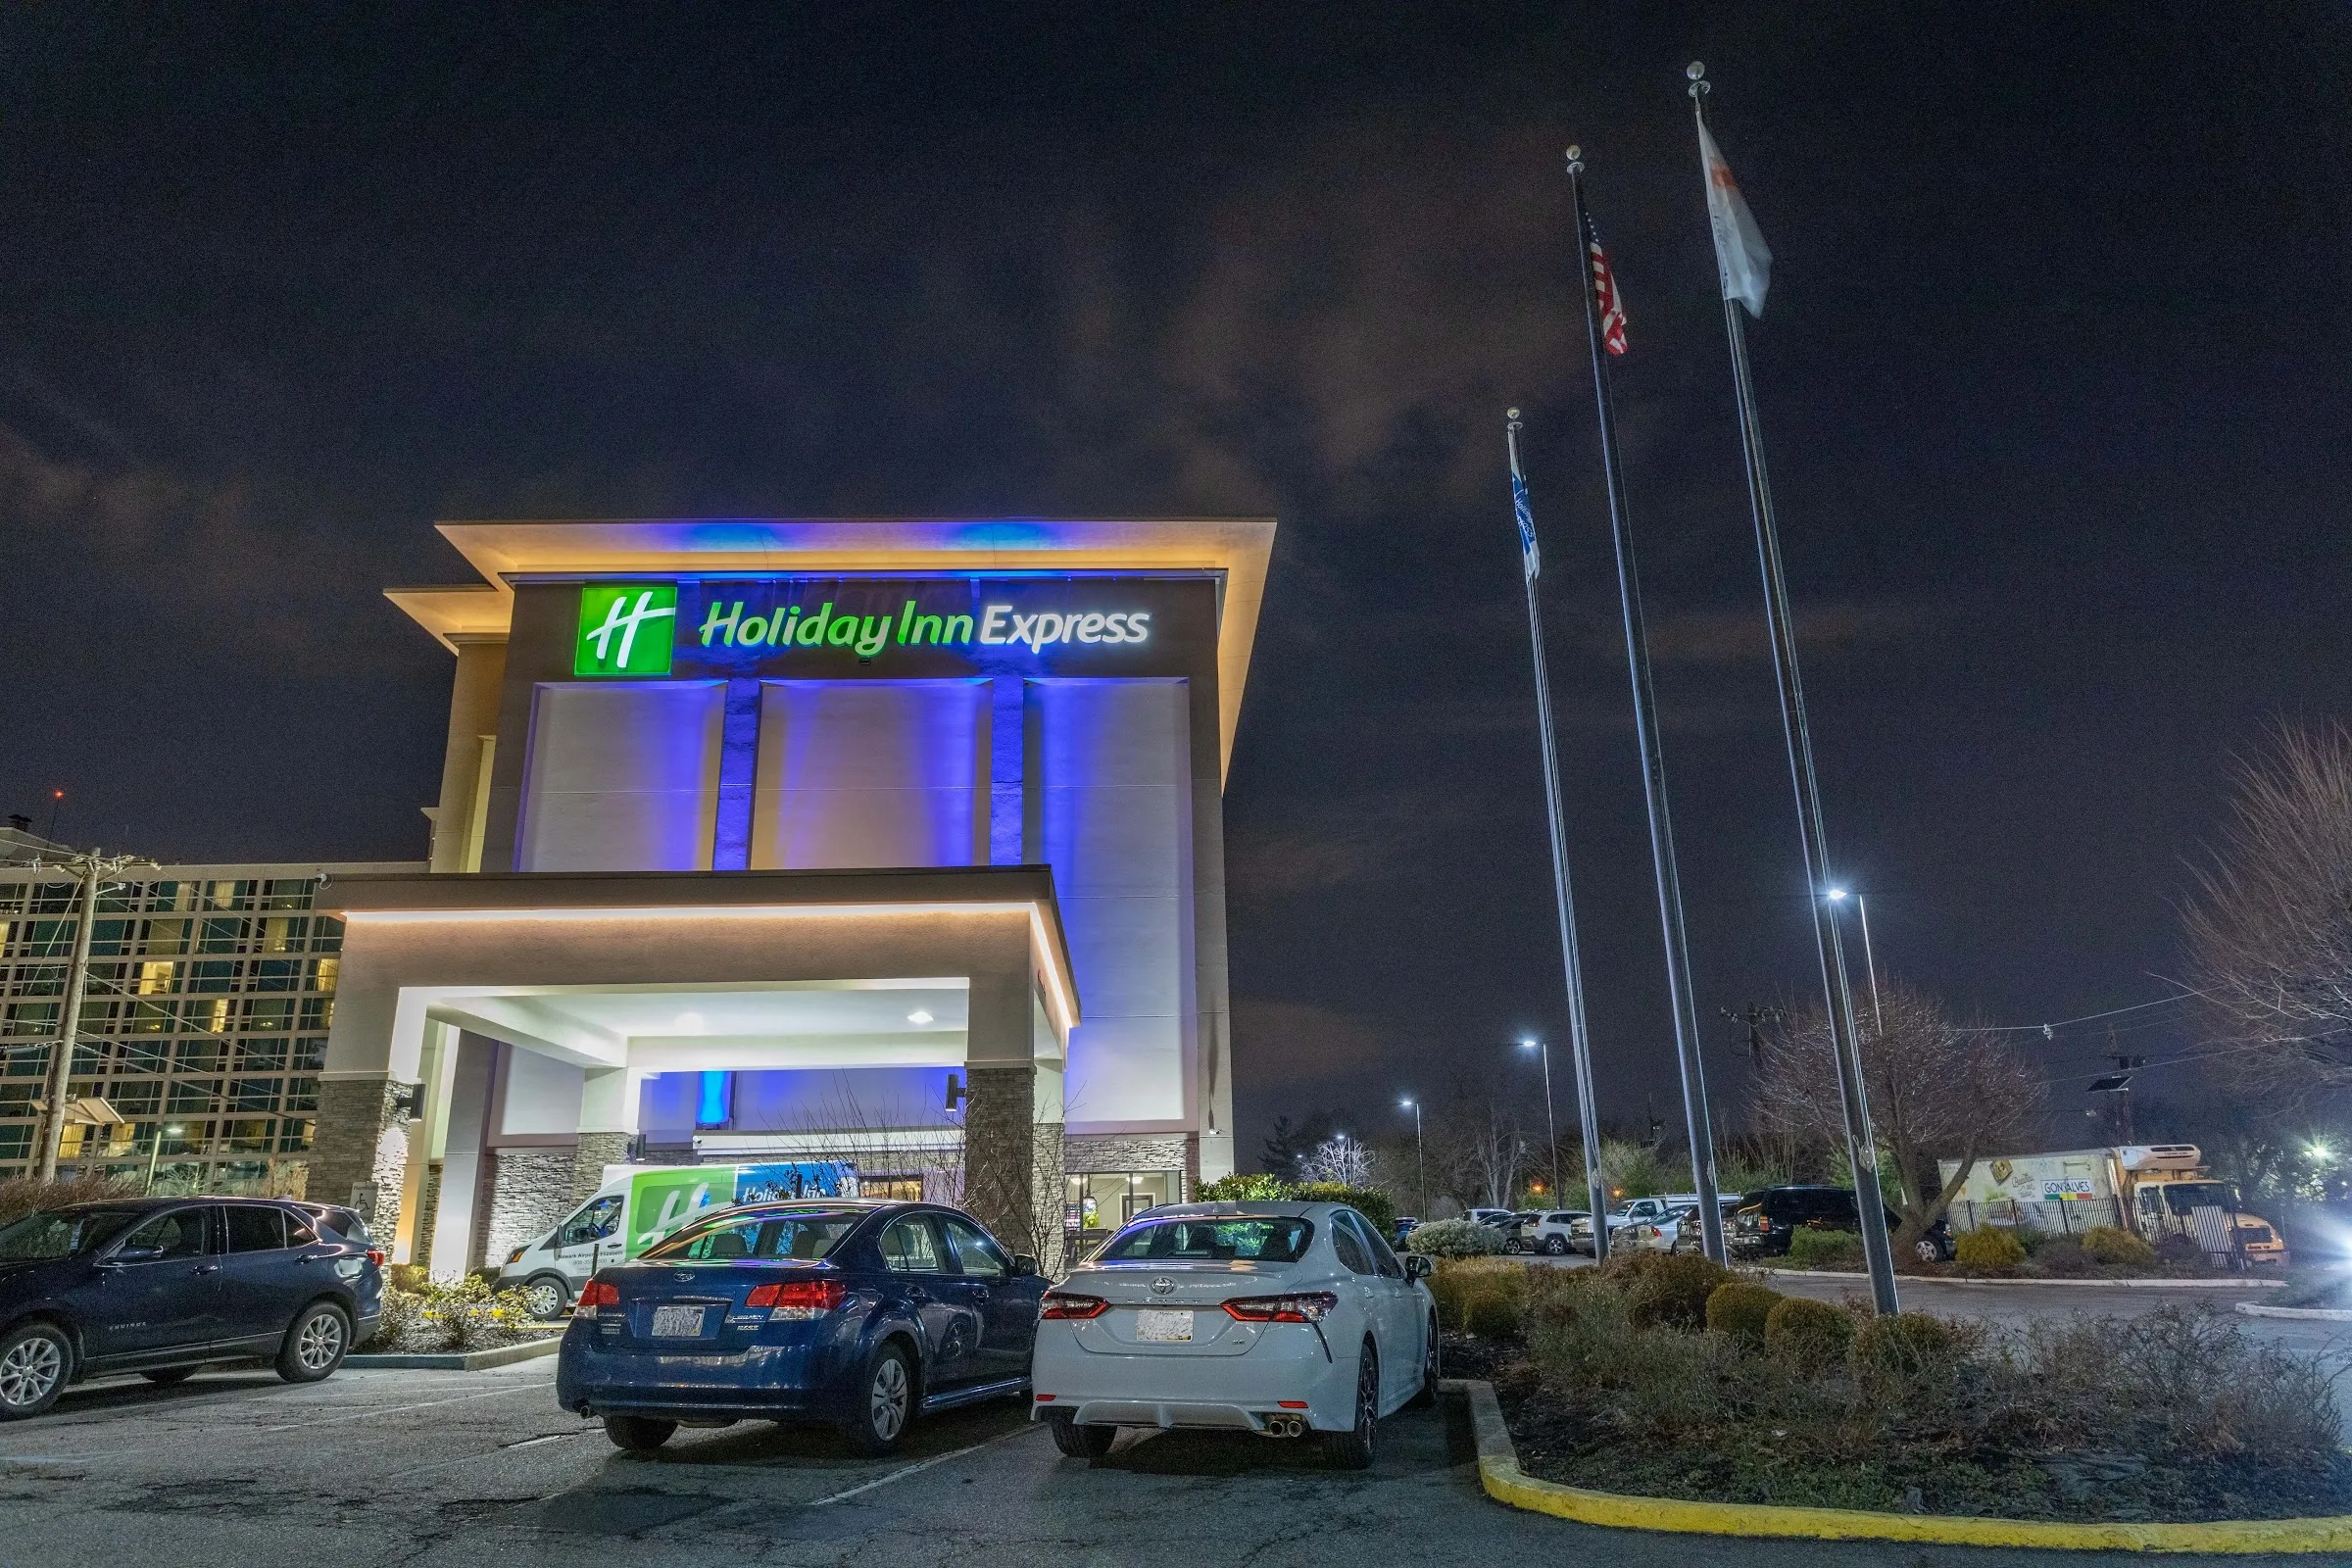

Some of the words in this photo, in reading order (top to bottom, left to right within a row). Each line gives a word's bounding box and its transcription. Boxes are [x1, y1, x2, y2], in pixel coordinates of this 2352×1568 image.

[699, 602, 892, 656] Holiday
[897, 600, 974, 645] Inn
[980, 605, 1151, 655] Express
